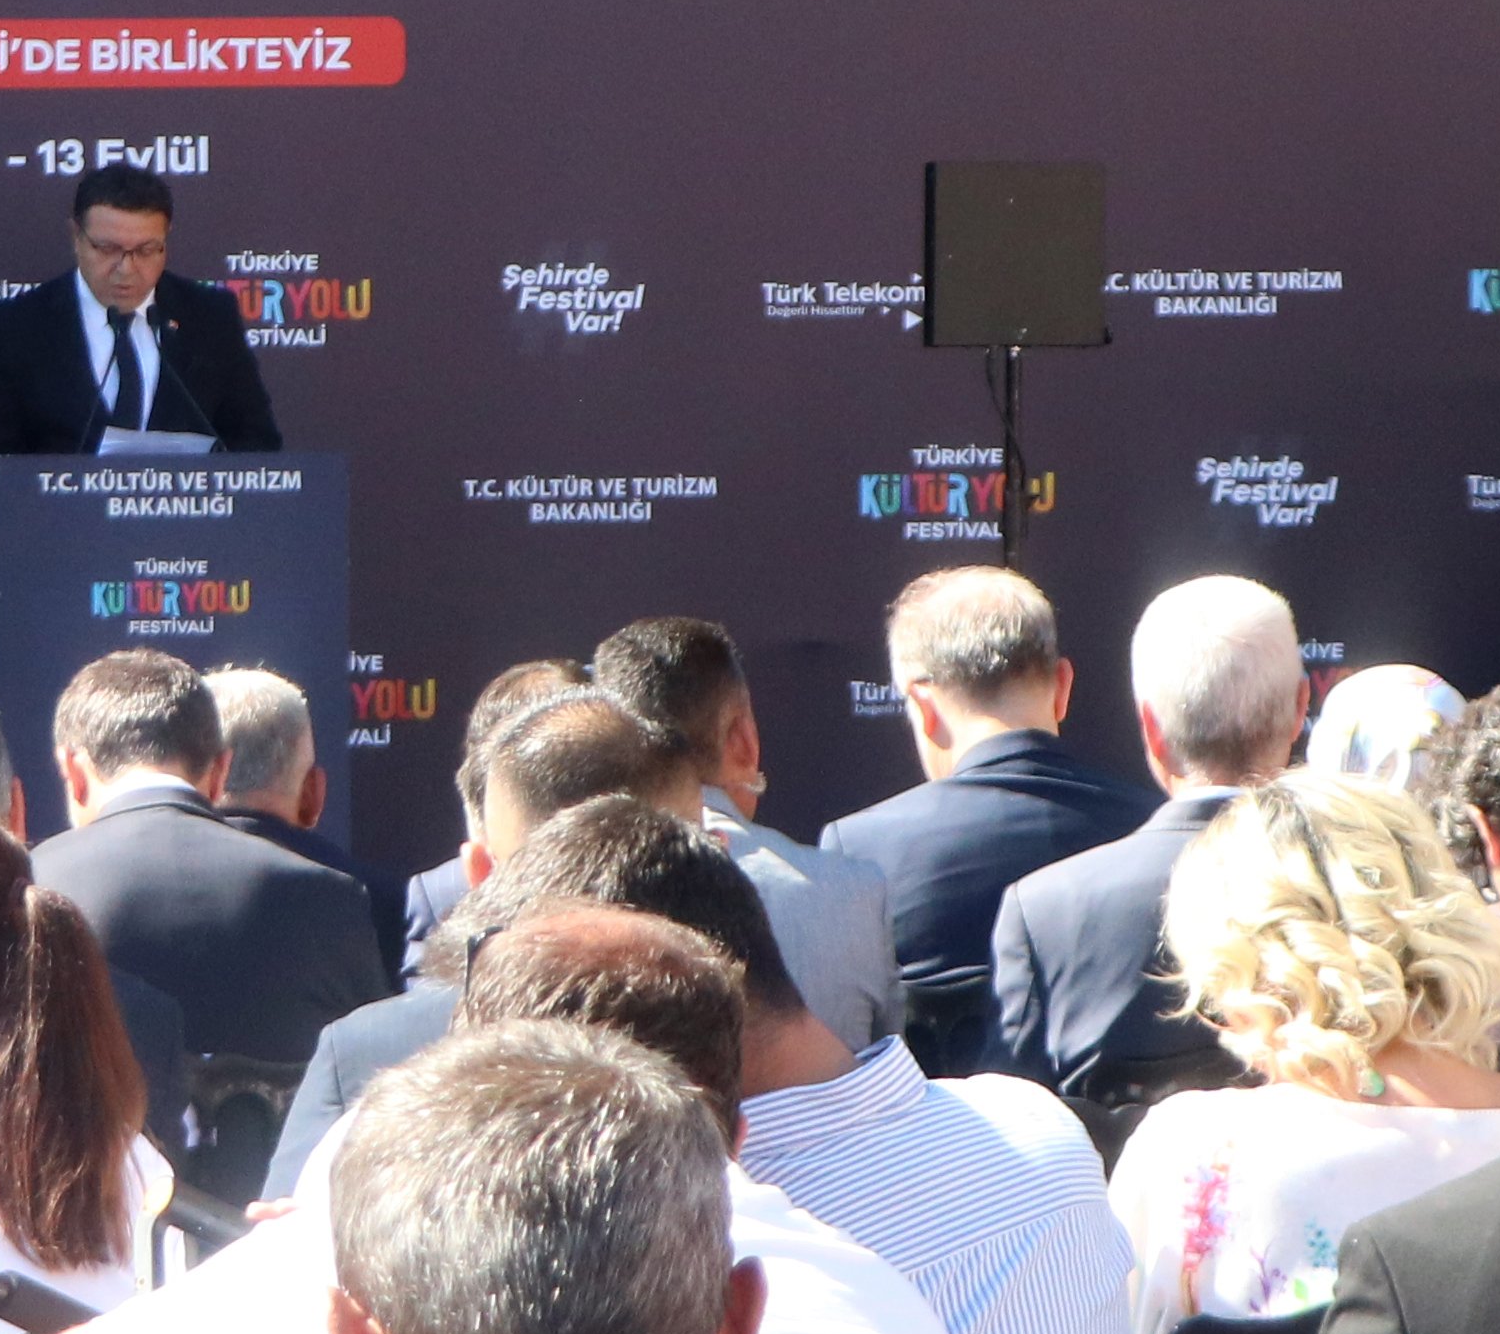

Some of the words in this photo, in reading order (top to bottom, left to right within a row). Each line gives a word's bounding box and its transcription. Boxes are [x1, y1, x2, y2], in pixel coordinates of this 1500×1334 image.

[89, 27, 350, 72] BİRLİKTEYİZ
[37, 138, 85, 175] 13
[228, 251, 318, 273] TÜRKİYE
[504, 265, 609, 289] Şehirde
[1105, 274, 1129, 291] .C.
[1134, 271, 1220, 291] KÜLTÜR
[1224, 272, 1253, 289] VE
[1258, 268, 1342, 289] TURİZM
[519, 284, 644, 310] Festival
[764, 283, 816, 304] Türk
[825, 281, 925, 303] Telekom
[1158, 293, 1276, 316] BAKANLIĞI
[566, 311, 622, 332] Var!
[248, 324, 326, 346] STİVALİ
[913, 445, 1004, 465] TÜRKİYE
[40, 474, 78, 492] T.C.
[85, 469, 174, 491] KÜLTÜR
[179, 473, 209, 490] VE
[214, 468, 301, 489] TURİZM
[1198, 456, 1302, 482] Şehirde
[465, 480, 502, 498] T.C.
[508, 476, 594, 497] KÜLTÜR
[598, 478, 627, 495] VE
[632, 474, 717, 495] TURİZM
[1212, 477, 1337, 503] Festival
[109, 493, 233, 516] BAKANLIĞI
[532, 498, 651, 521] BAKANLIĞI
[1258, 503, 1317, 525] Var!
[906, 517, 1003, 539] FESTİVAL
[135, 557, 208, 574] TÜRKİYE
[129, 616, 214, 635] FESTİVALİ
[850, 681, 897, 701] Tür
